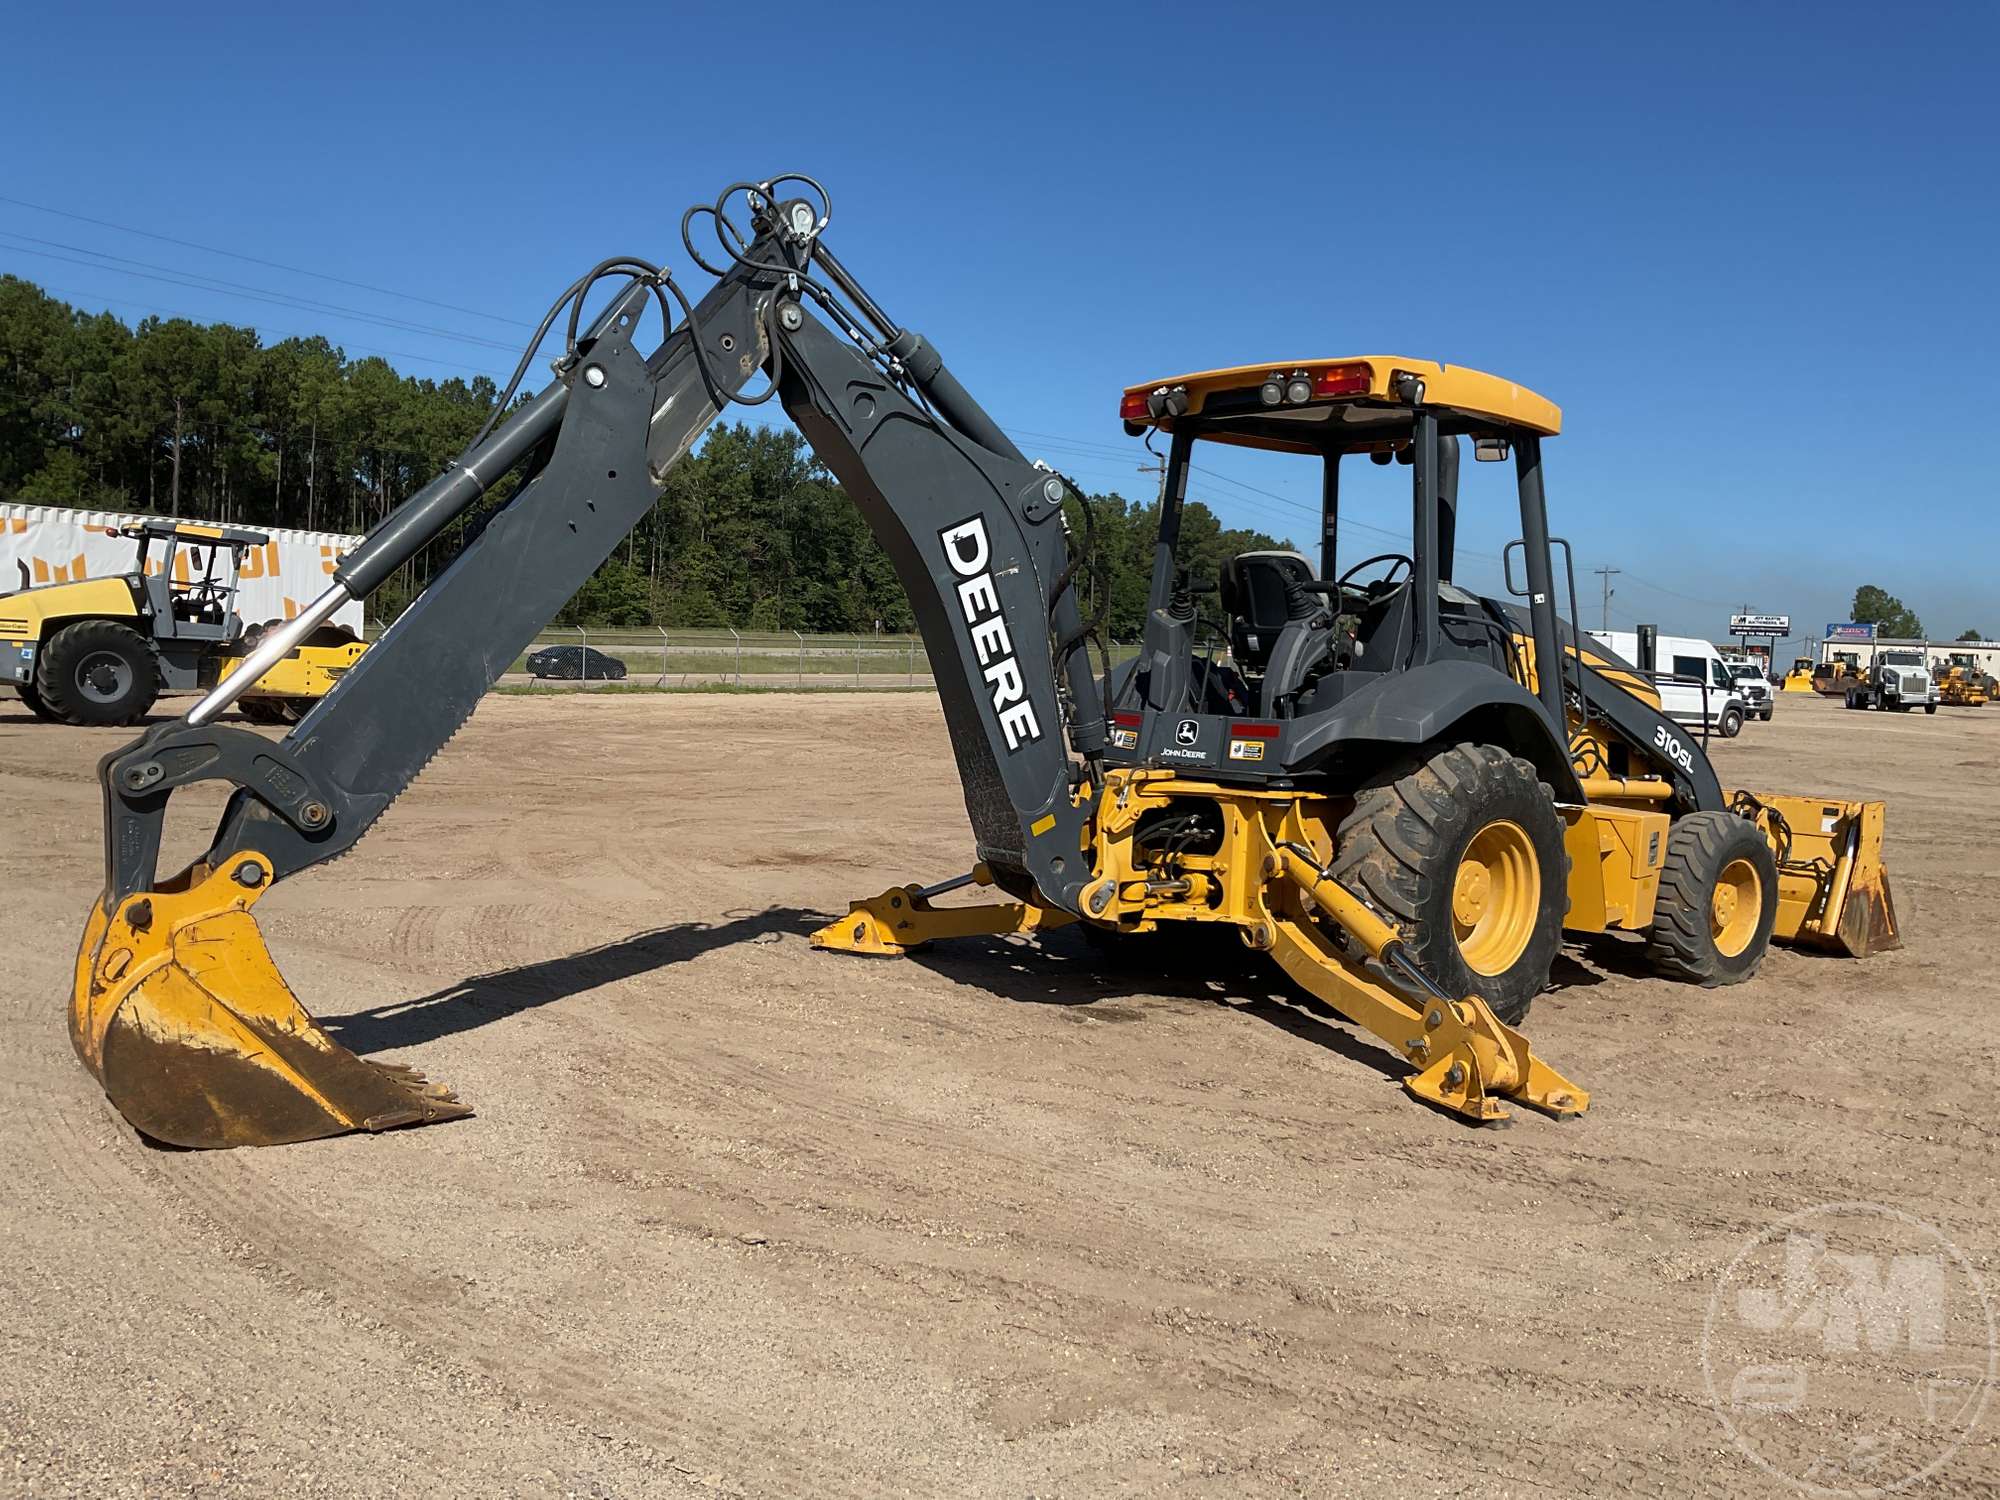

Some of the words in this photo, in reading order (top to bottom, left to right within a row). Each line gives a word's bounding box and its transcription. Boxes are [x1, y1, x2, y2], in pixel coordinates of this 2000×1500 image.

[941, 517, 1041, 752] DEERE
[1160, 747, 1181, 757] JOHN
[1182, 749, 1207, 759] DEERE
[1653, 725, 1694, 774] 310SL
